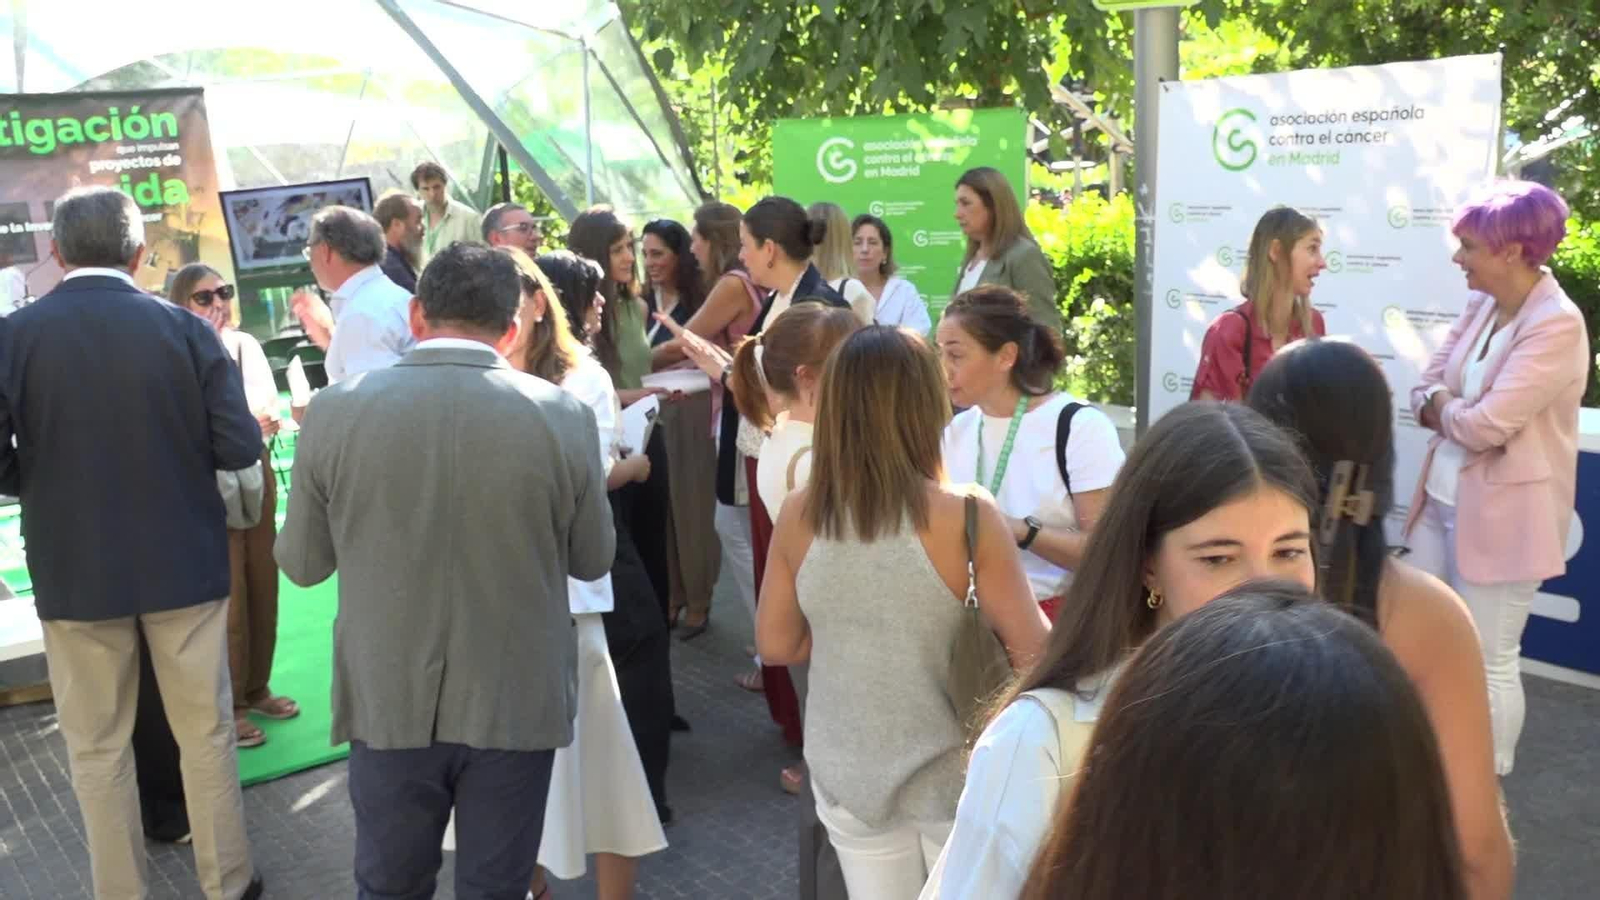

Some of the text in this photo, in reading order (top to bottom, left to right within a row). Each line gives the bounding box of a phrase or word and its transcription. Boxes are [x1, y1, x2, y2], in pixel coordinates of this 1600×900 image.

[1270, 105, 1425, 126] asociación española
[0, 105, 178, 154] tigación
[1268, 127, 1388, 146] contra el cáncer
[89, 153, 182, 174] proyectos de
[864, 154, 901, 165] contra
[1267, 150, 1341, 167] en Madrid
[864, 166, 921, 178] en Madrid
[113, 172, 189, 206] ida
